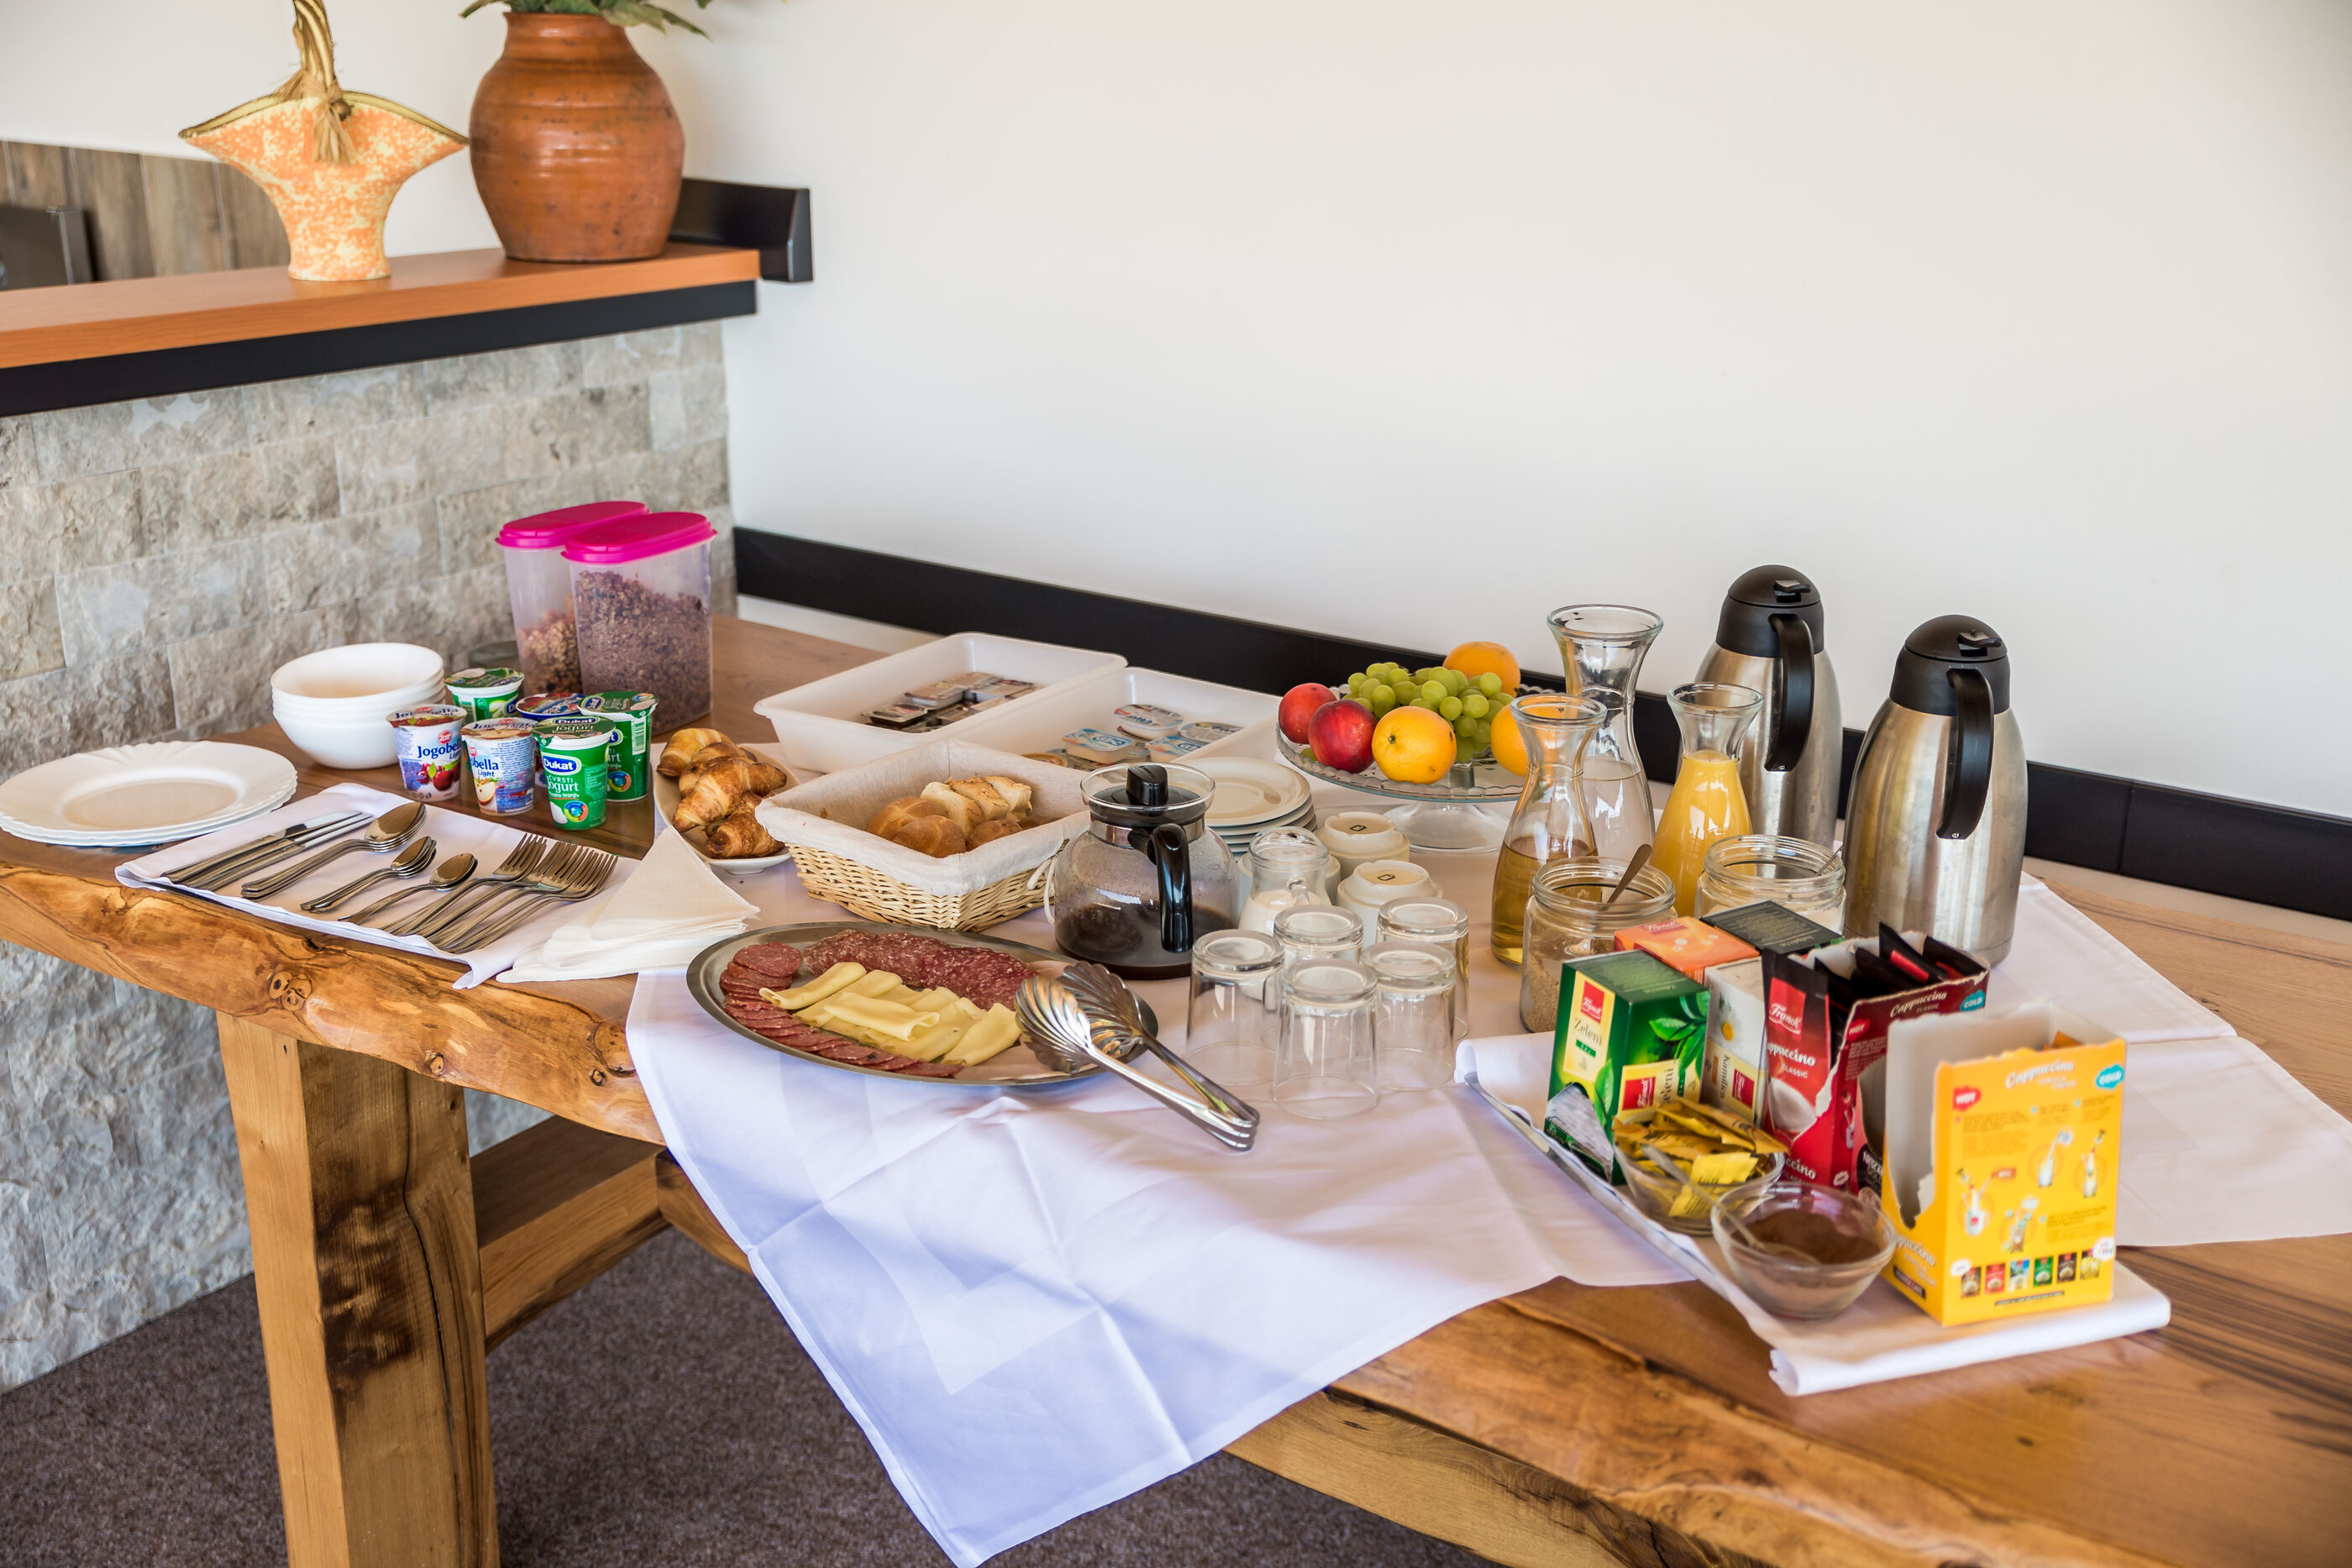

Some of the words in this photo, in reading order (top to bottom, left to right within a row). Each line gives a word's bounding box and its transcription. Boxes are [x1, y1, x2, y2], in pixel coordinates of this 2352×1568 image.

[470, 757, 499, 771] obella
[477, 769, 495, 778] Light
[543, 758, 574, 771] Dukat
[1890, 990, 1947, 1018] Cappuccino
[1963, 996, 1983, 1008] COLD
[1769, 1003, 1803, 1030] Franck
[1573, 1017, 1604, 1046] Zeleni
[1781, 1062, 1809, 1079] CLASSIC
[2005, 1060, 2075, 1089] Cappuccino
[1660, 1067, 1674, 1105] eleni
[1862, 1150, 1882, 1176] NESCA
